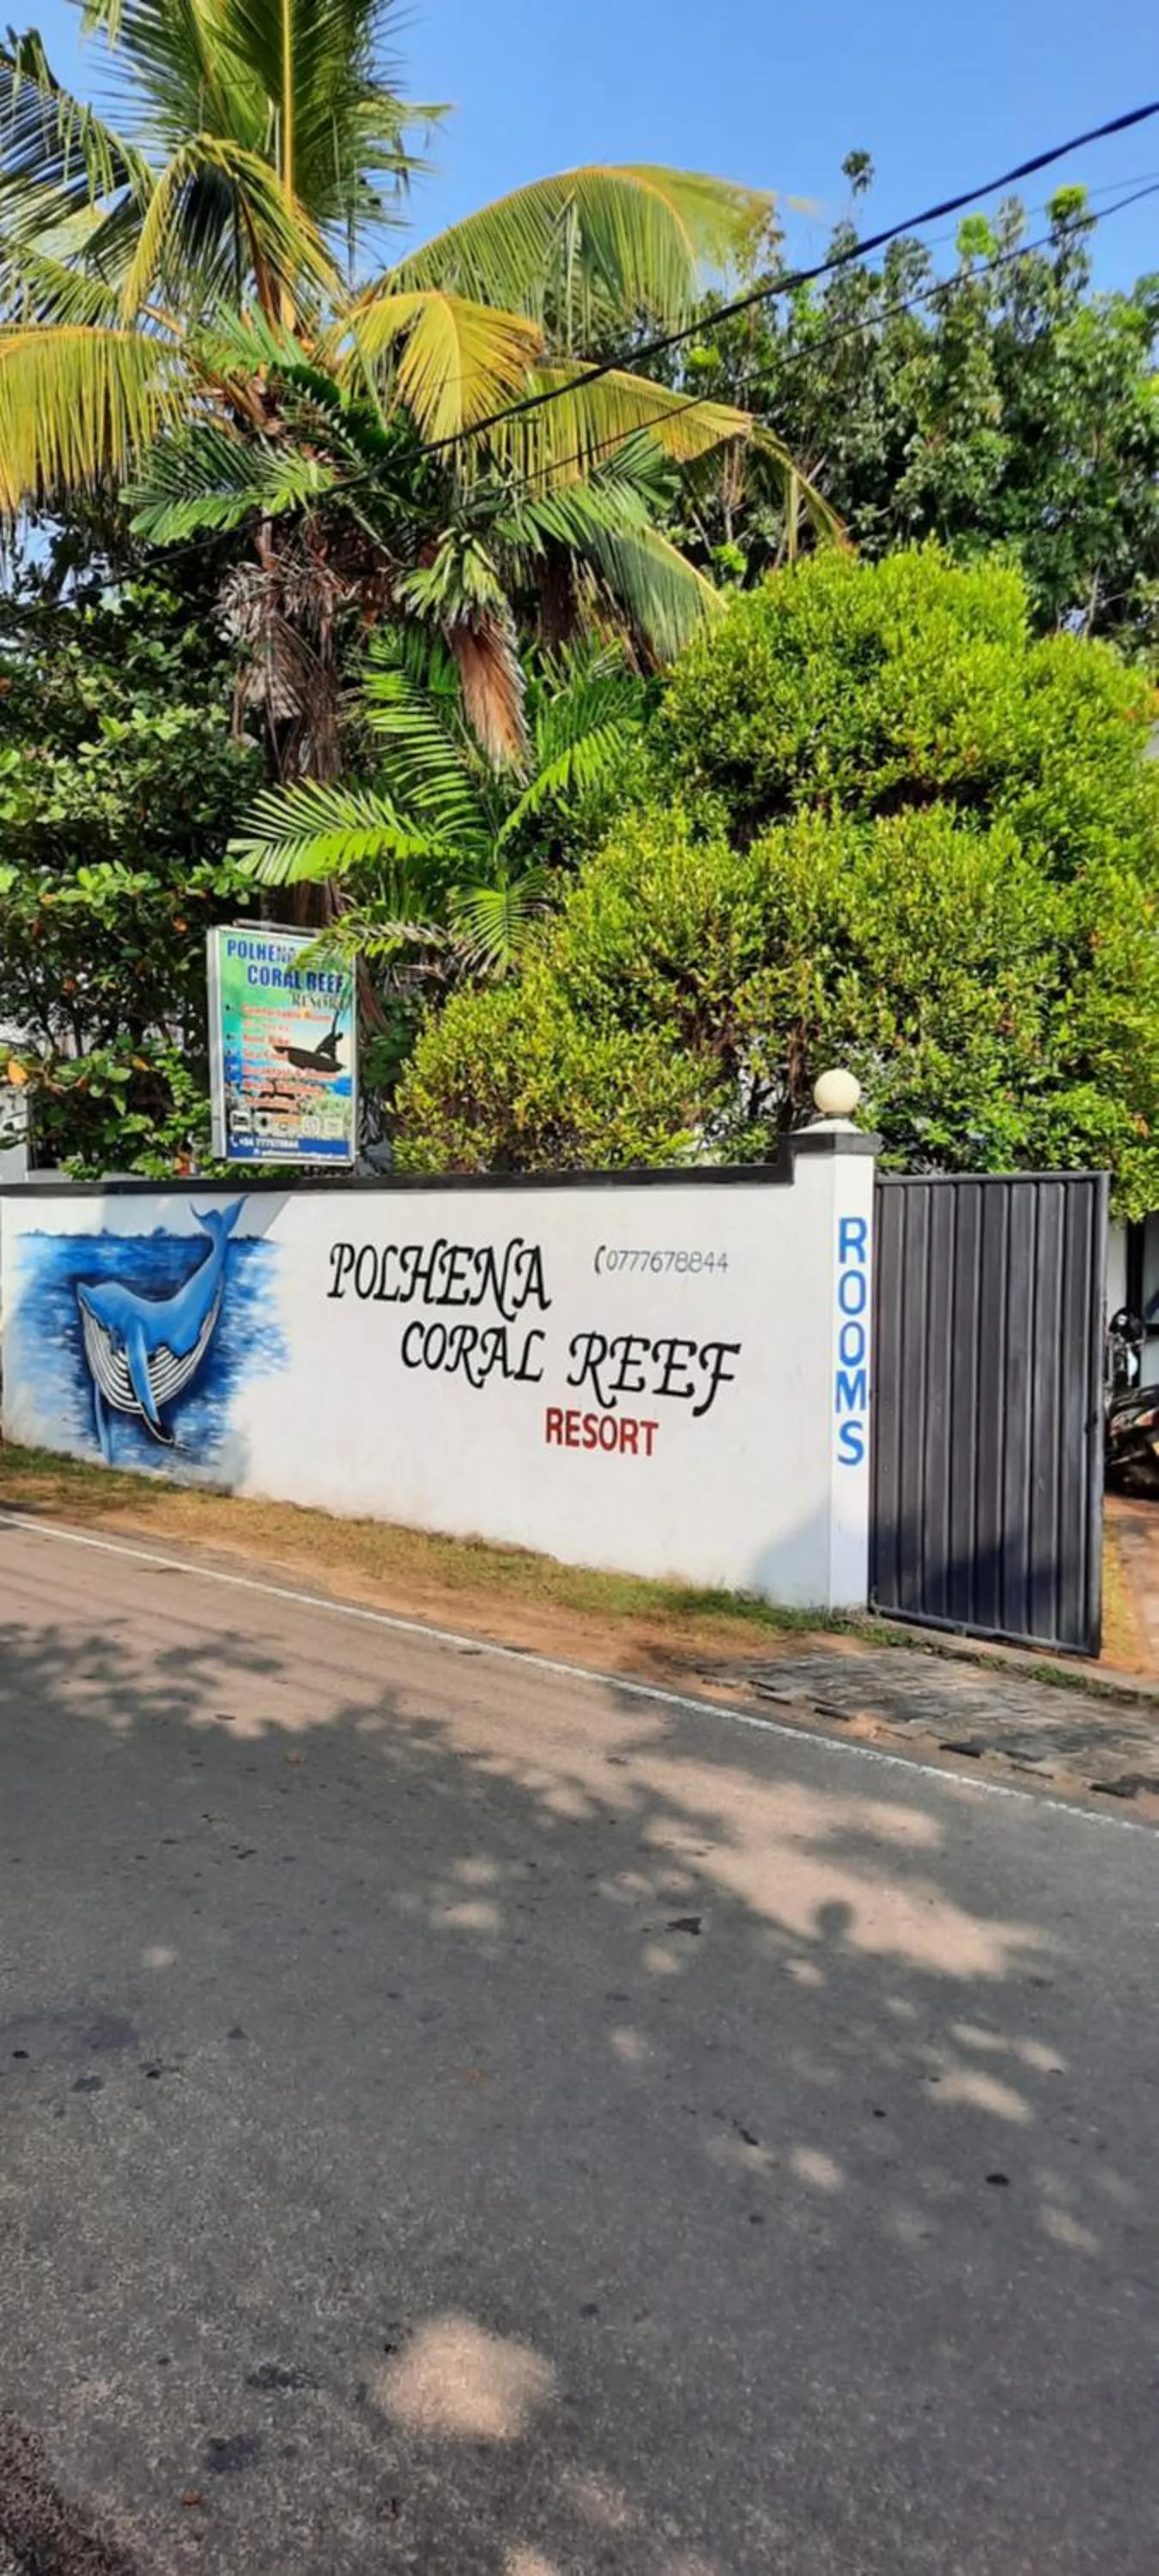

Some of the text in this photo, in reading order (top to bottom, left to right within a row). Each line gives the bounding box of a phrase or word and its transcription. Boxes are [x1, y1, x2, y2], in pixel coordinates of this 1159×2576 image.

[247, 964, 343, 993] CORAL REEF
[327, 1238, 551, 1321] POLHENA
[606, 1249, 728, 1273] 0777678844
[401, 1321, 741, 1417] CORAL REEF
[835, 1217, 867, 1466] ROOMS
[545, 1407, 658, 1456] RESORT
